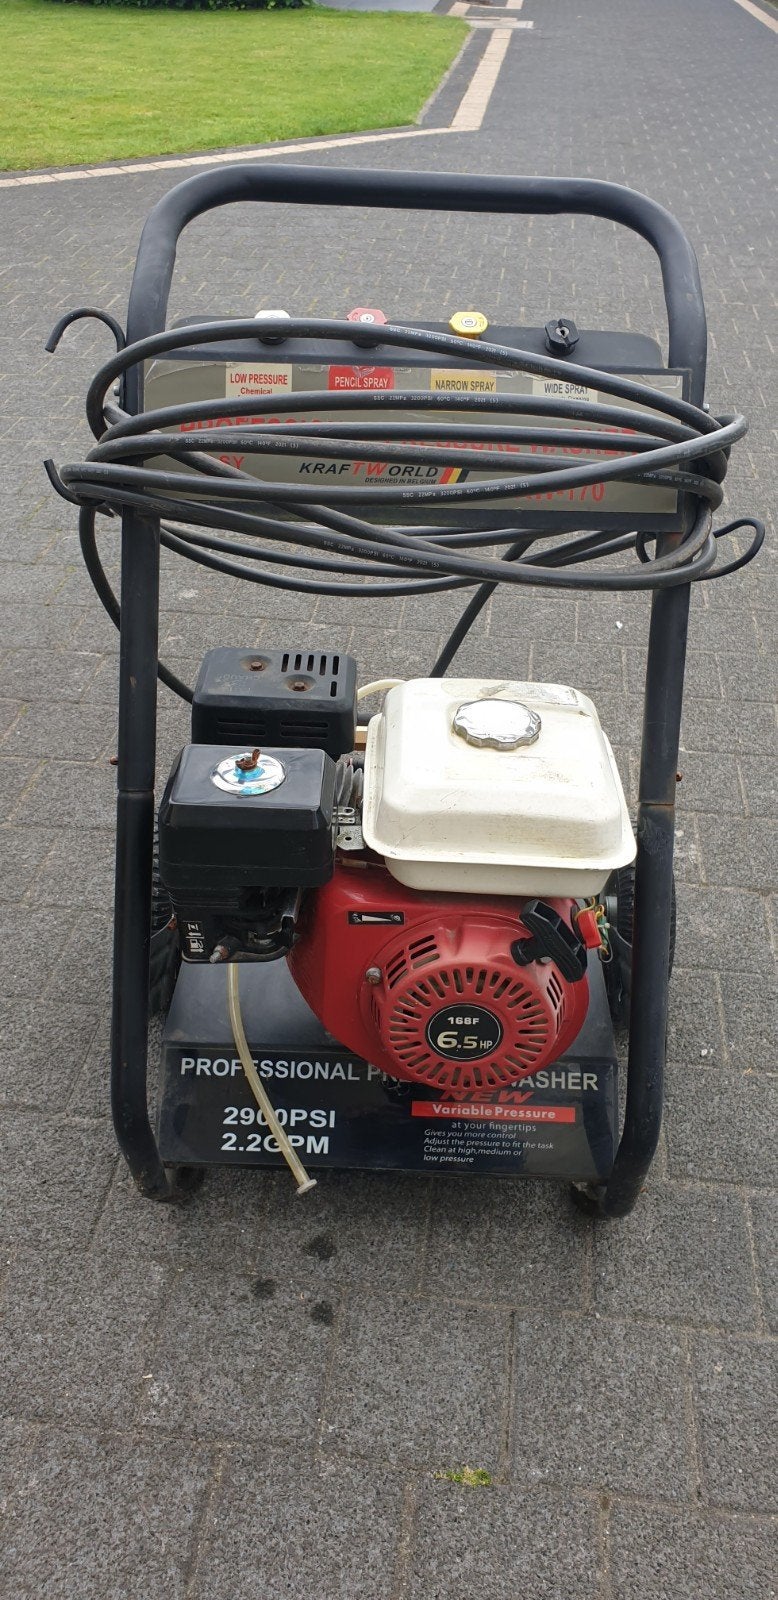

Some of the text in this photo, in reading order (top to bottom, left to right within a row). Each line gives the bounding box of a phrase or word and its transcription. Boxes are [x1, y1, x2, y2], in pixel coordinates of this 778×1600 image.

[230, 373, 288, 385] LOW PRESSURE
[334, 376, 389, 389] PENCIL SPRAY
[240, 387, 273, 395] Chemical
[435, 380, 495, 392] NARROW SPRAY
[544, 383, 588, 394] WIDE SPRAY
[299, 460, 439, 477] KRAFTWORLD
[447, 1016, 480, 1025] 168F
[437, 1031, 493, 1049] 6.5 HP
[511, 1070, 599, 1091] ASHER
[222, 1106, 336, 1128] 2900PSI
[432, 1104, 556, 1119] Variable Pressure
[424, 1129, 446, 1137] Gives
[464, 1123, 487, 1131] your
[489, 1122, 537, 1133] fingertips
[220, 1132, 329, 1154] 2.2GPM
[424, 1137, 450, 1146] Adjust
[452, 1138, 465, 1146] the
[465, 1140, 501, 1148] pressure
[522, 1141, 536, 1149] the
[424, 1145, 446, 1153] Clean
